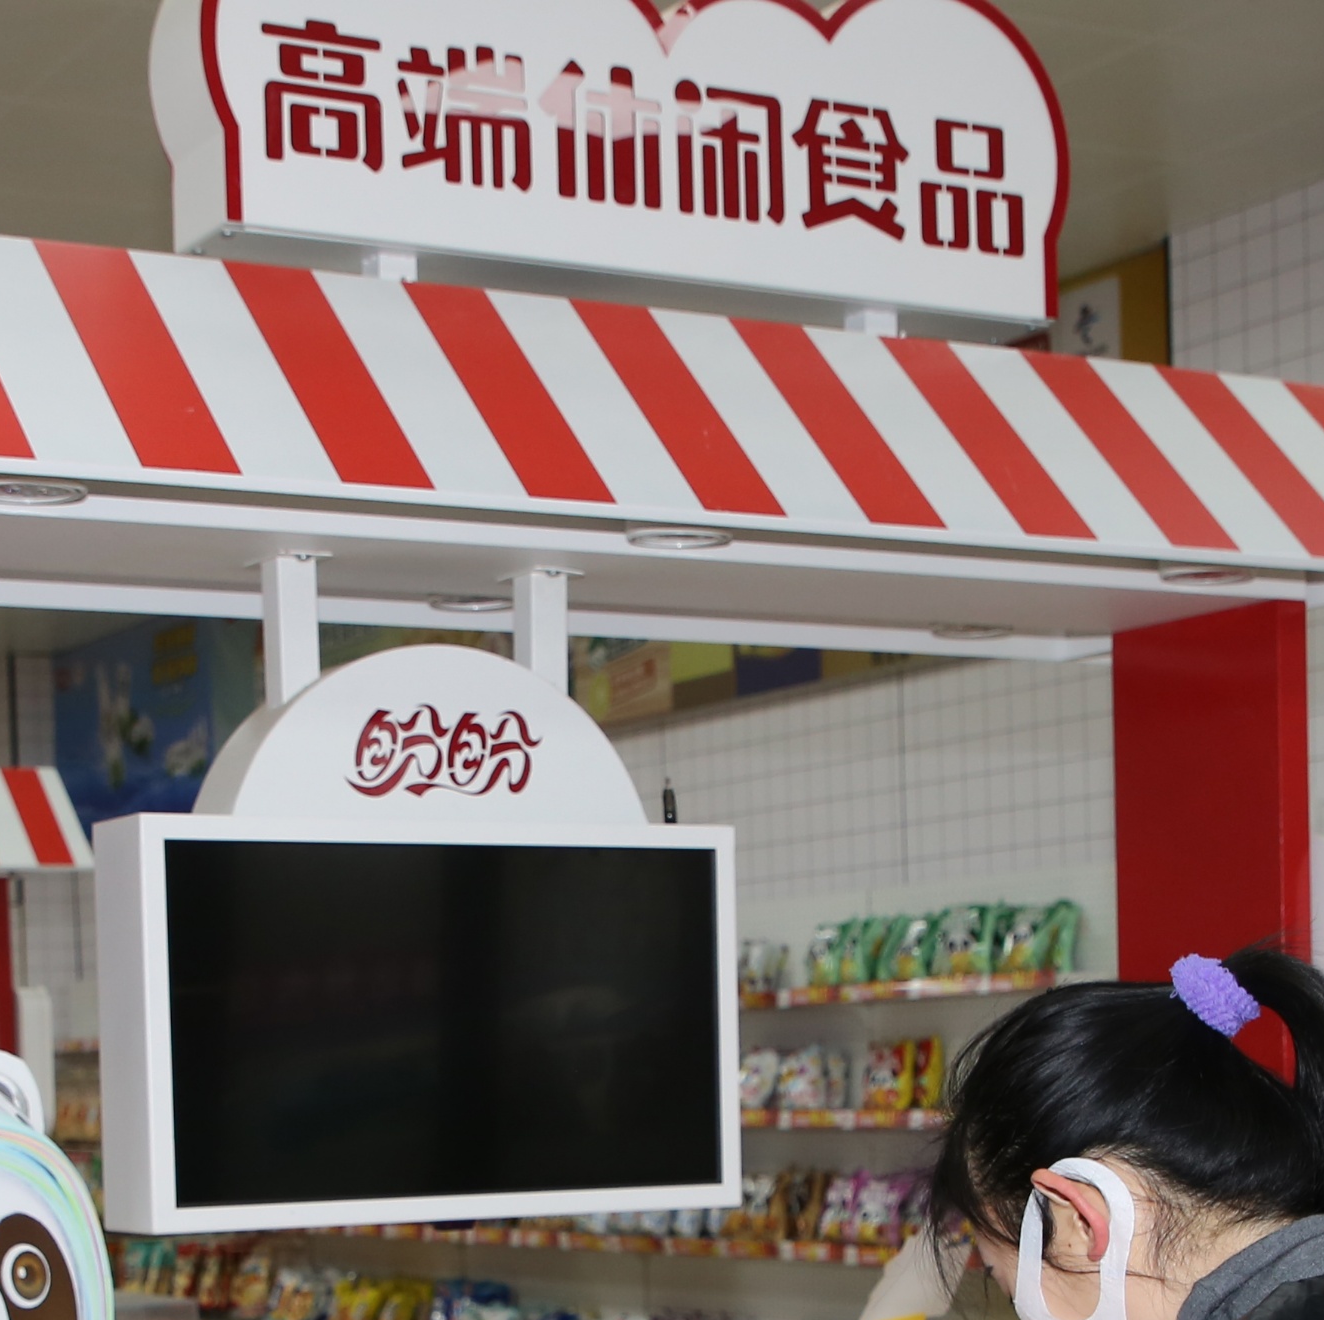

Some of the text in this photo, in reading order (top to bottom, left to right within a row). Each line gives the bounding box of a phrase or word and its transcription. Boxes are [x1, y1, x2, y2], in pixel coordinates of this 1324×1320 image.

[261, 20, 1026, 258] 高端休闲食品
[346, 705, 541, 796] 盼盼
